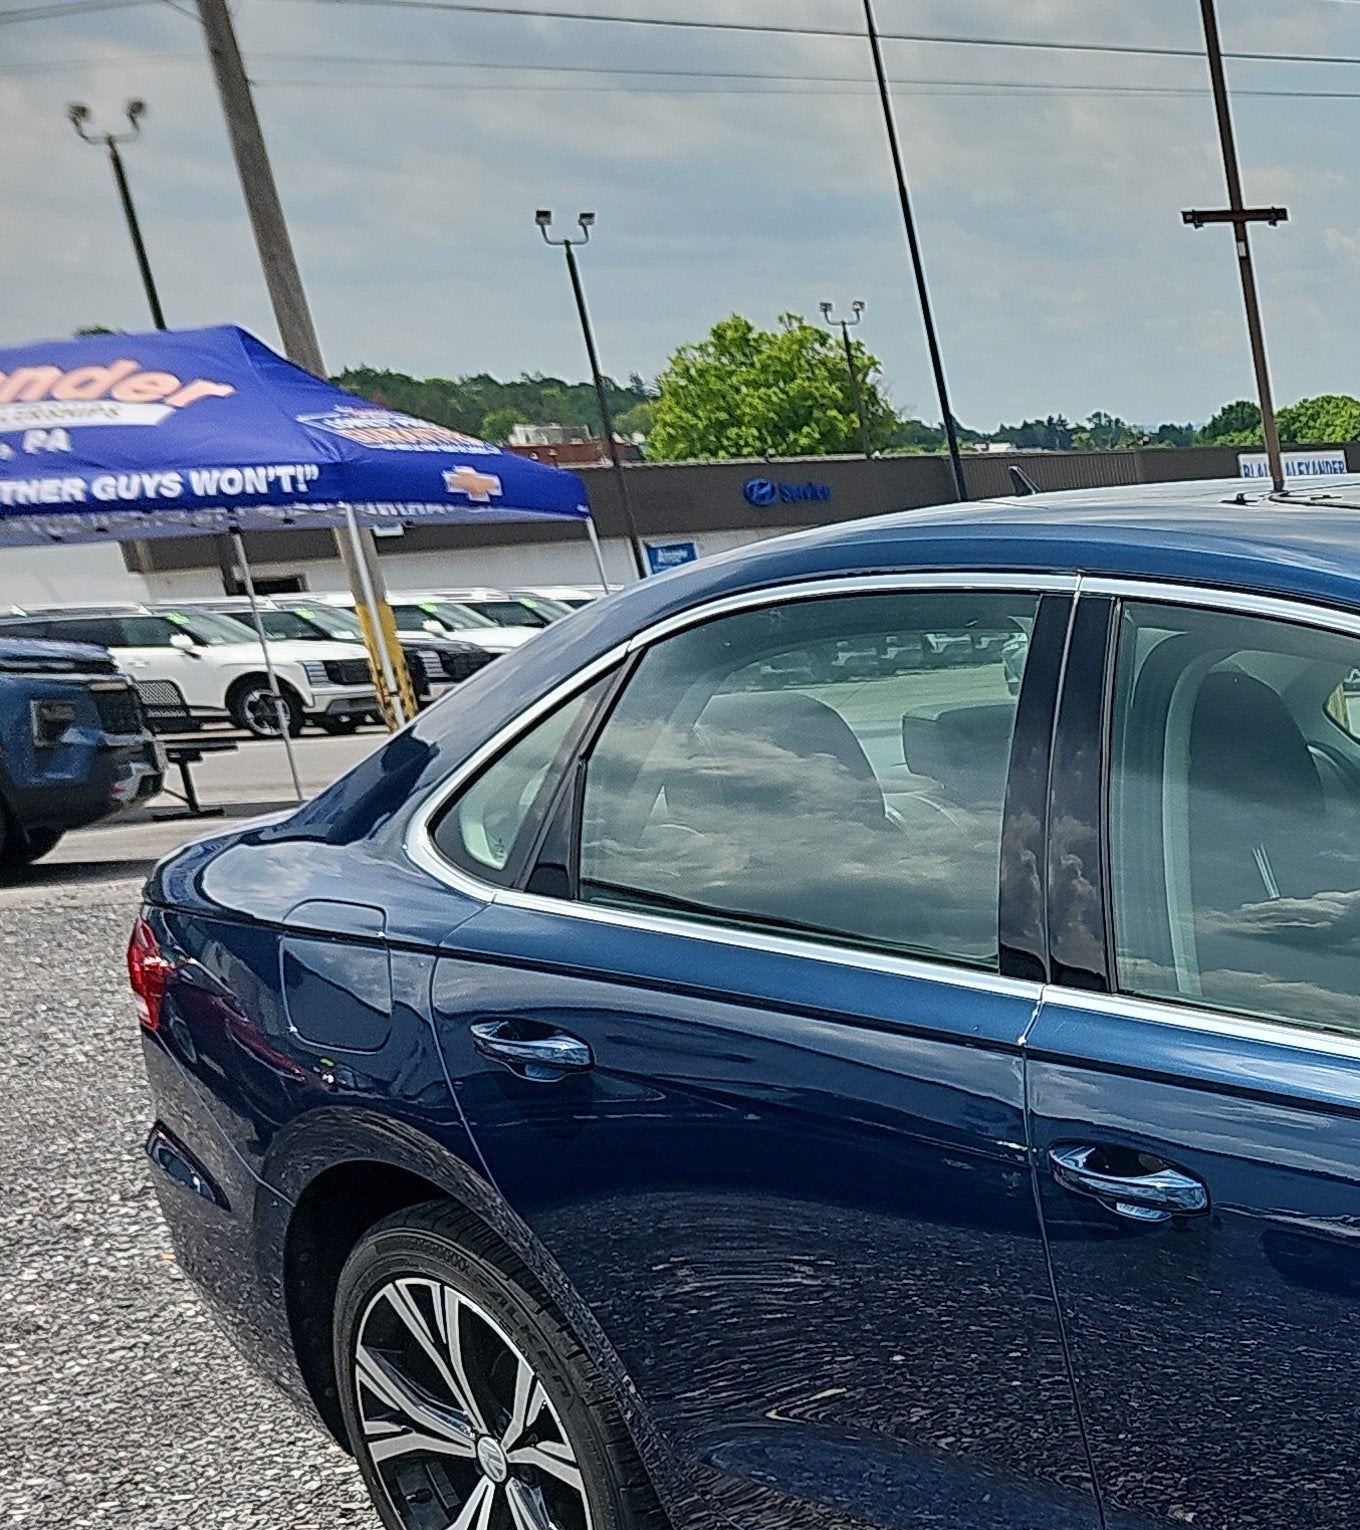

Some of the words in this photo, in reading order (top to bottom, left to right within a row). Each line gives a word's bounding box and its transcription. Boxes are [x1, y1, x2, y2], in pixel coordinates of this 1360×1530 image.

[0, 359, 237, 408] nder
[22, 427, 72, 454] PA
[1285, 459, 1345, 477] ALEXANDER
[91, 471, 183, 501] GUYS
